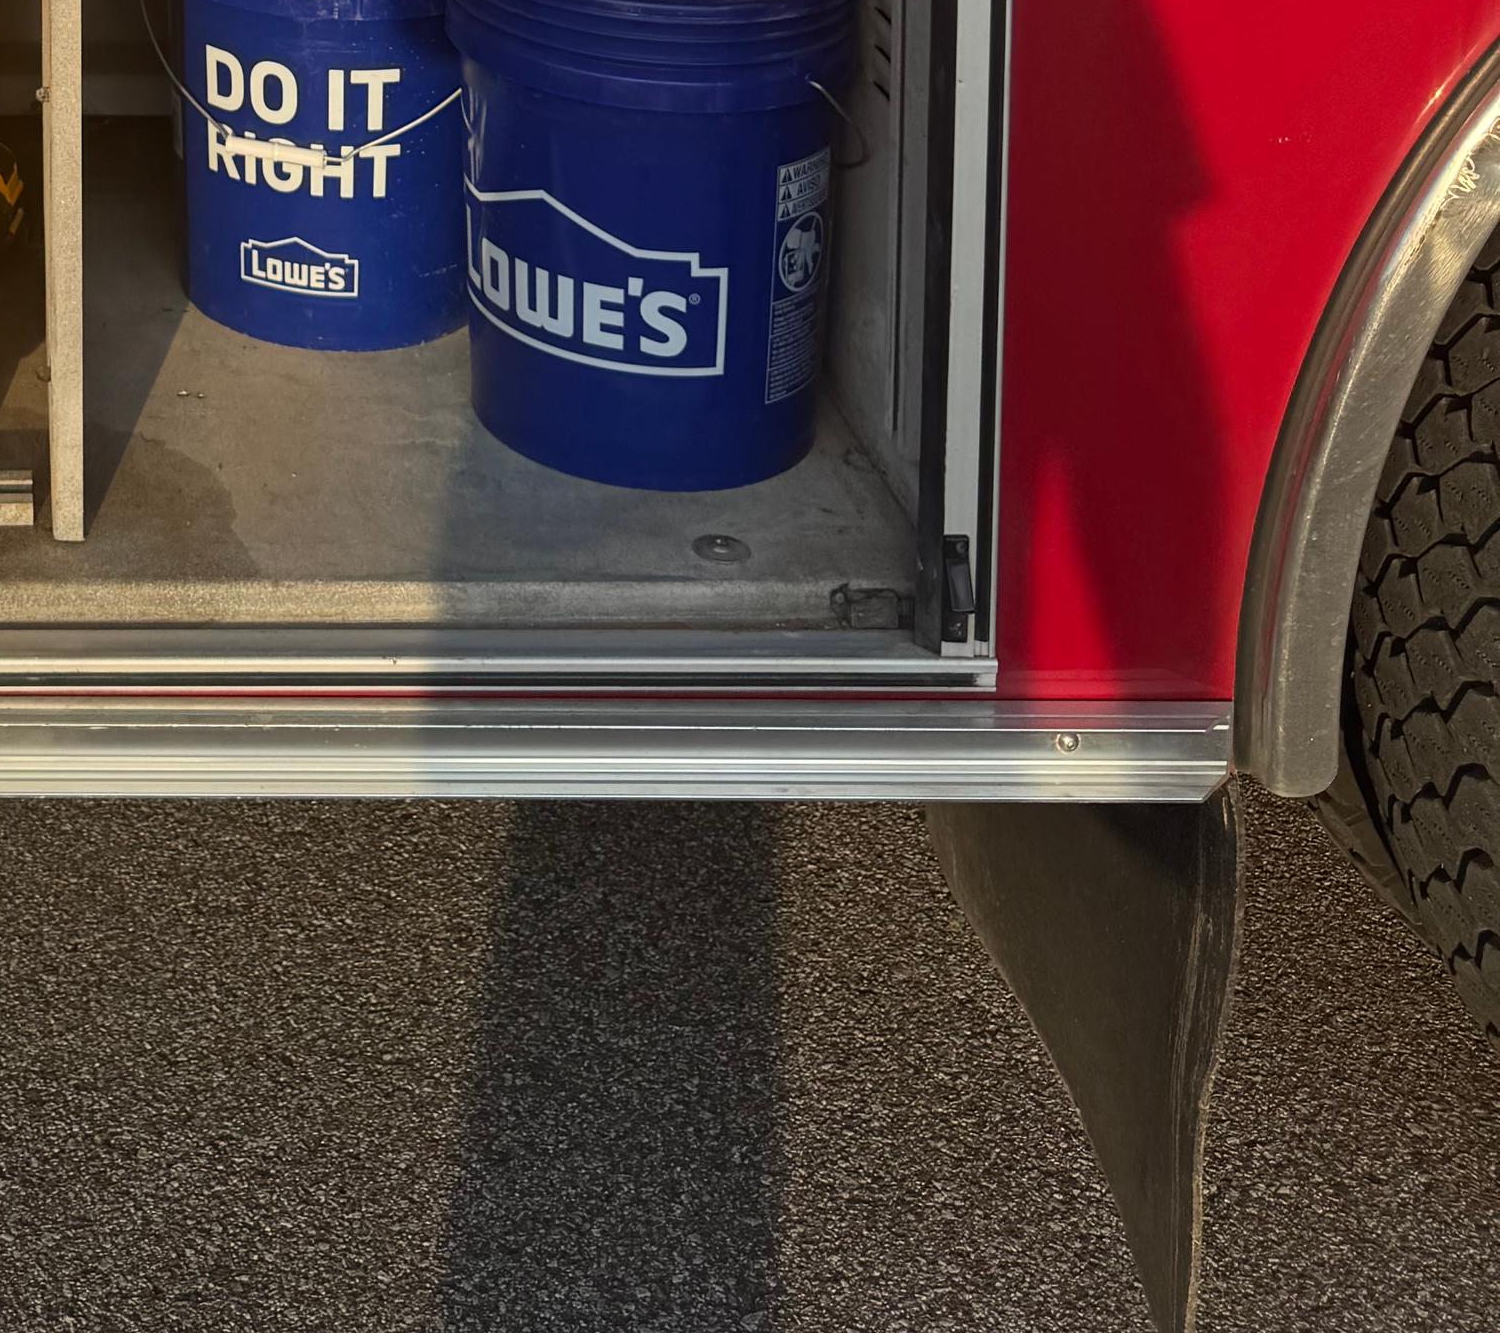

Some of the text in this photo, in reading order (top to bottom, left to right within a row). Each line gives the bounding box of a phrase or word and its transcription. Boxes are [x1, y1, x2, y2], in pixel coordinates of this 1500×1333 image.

[206, 44, 401, 131] DO IT
[207, 118, 401, 199] RIGHT
[252, 249, 346, 290] LOWE'S
[465, 203, 688, 358] LOWE'S
